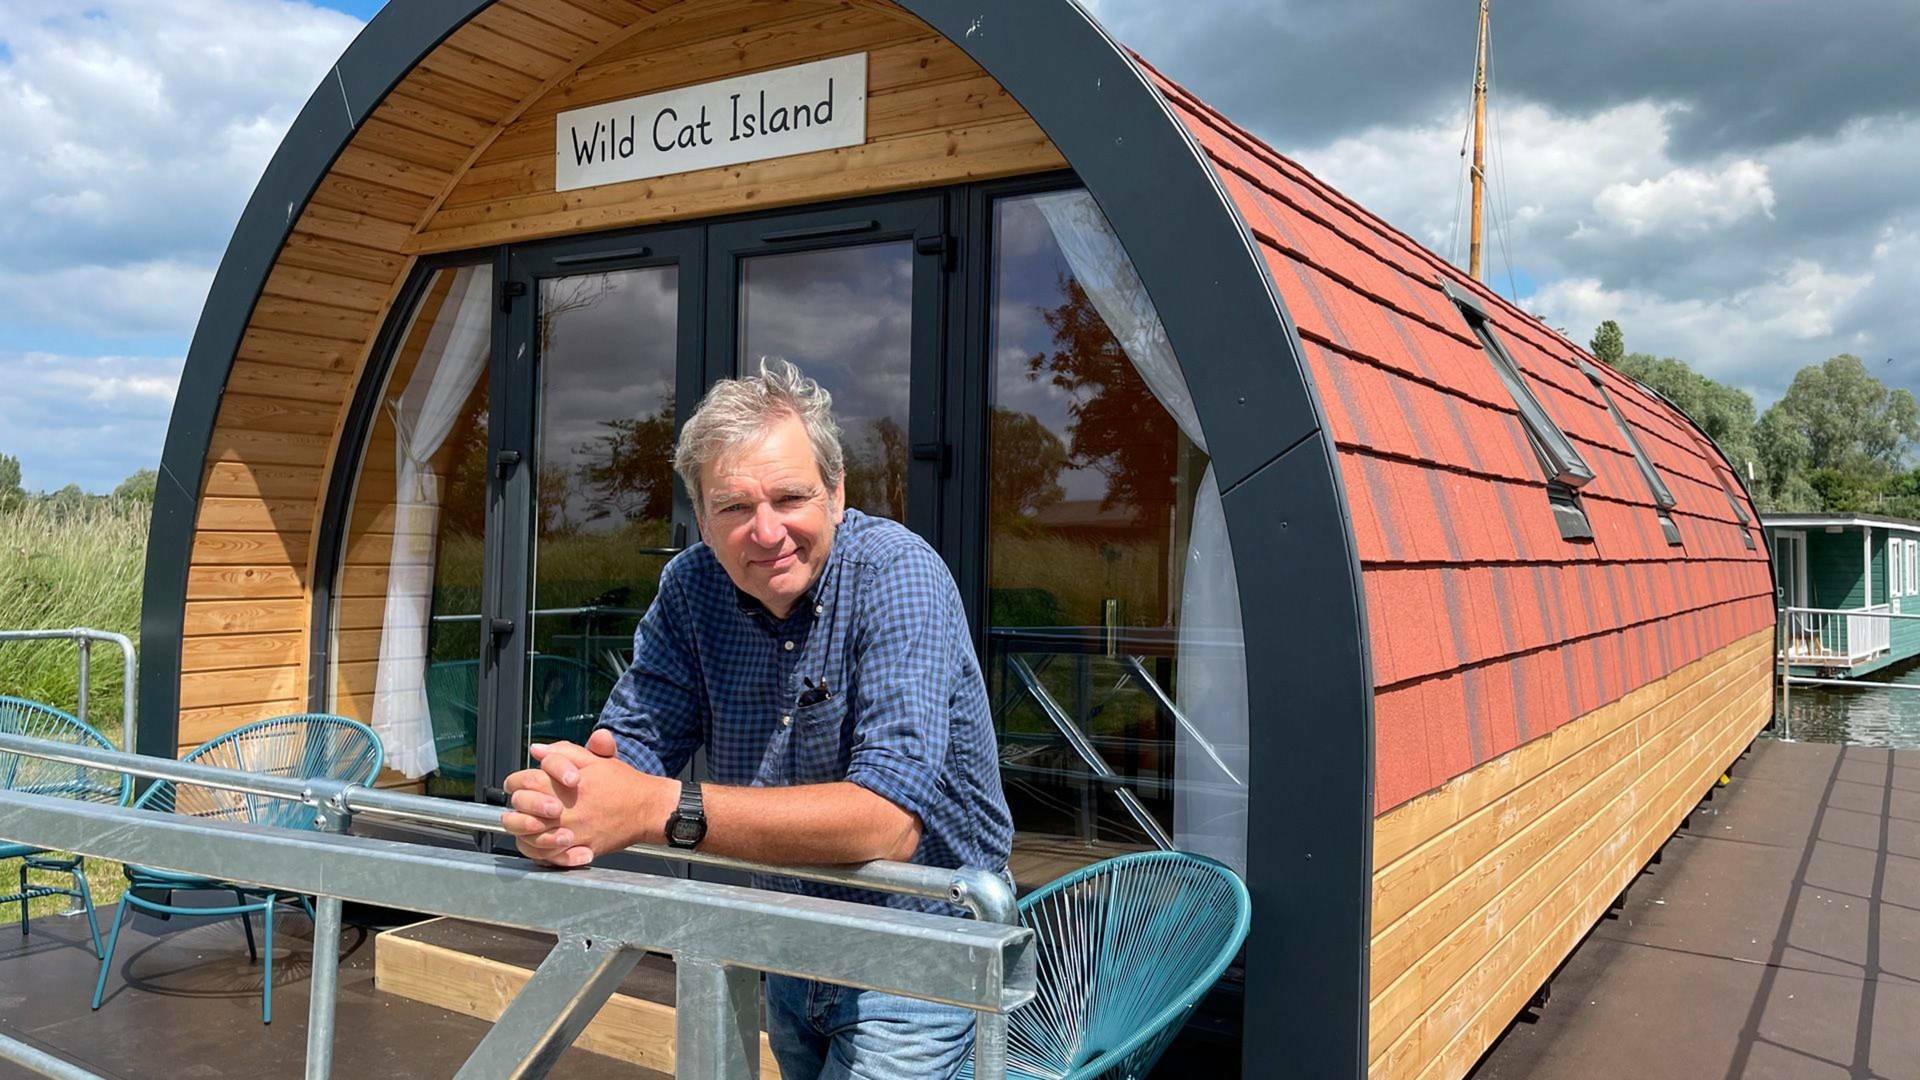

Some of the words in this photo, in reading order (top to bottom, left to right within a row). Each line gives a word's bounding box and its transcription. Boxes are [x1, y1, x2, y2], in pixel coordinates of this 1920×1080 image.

[571, 115, 635, 166] Wild
[652, 105, 713, 152] Cat
[729, 77, 834, 142] Island
